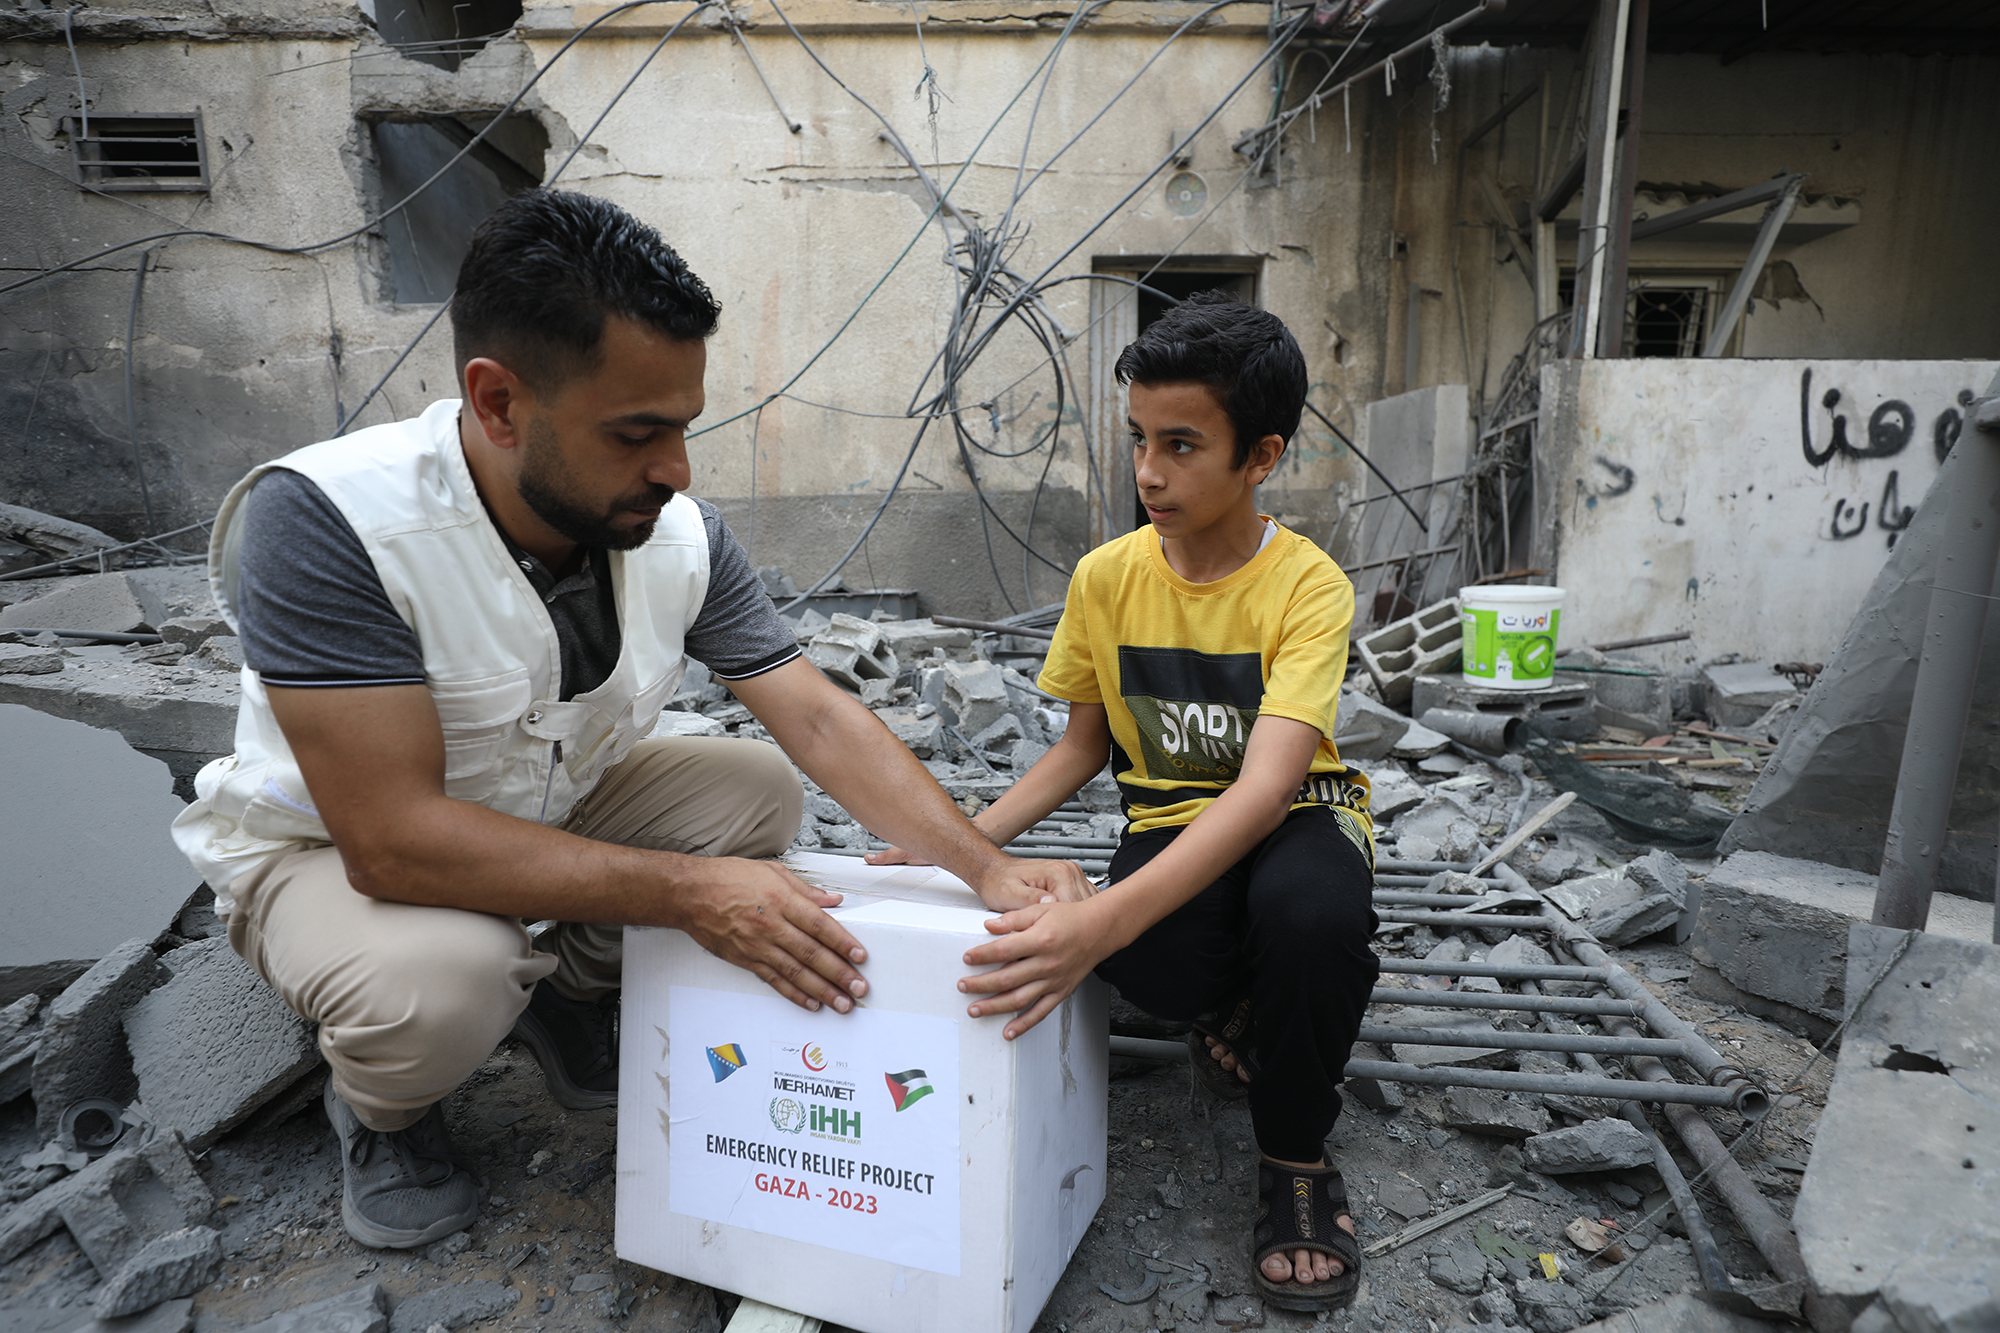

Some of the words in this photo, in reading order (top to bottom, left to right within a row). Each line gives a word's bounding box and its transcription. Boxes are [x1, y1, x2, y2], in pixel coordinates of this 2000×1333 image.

[835, 1061, 848, 1069] 1913
[774, 1077, 856, 1101] MERHAMET
[706, 1134, 798, 1168] EMERGENCY
[801, 1152, 856, 1180] RELIEF
[861, 1162, 935, 1195] PROJECT
[754, 1173, 810, 1201] GAZA
[827, 1187, 878, 1214] 2023
